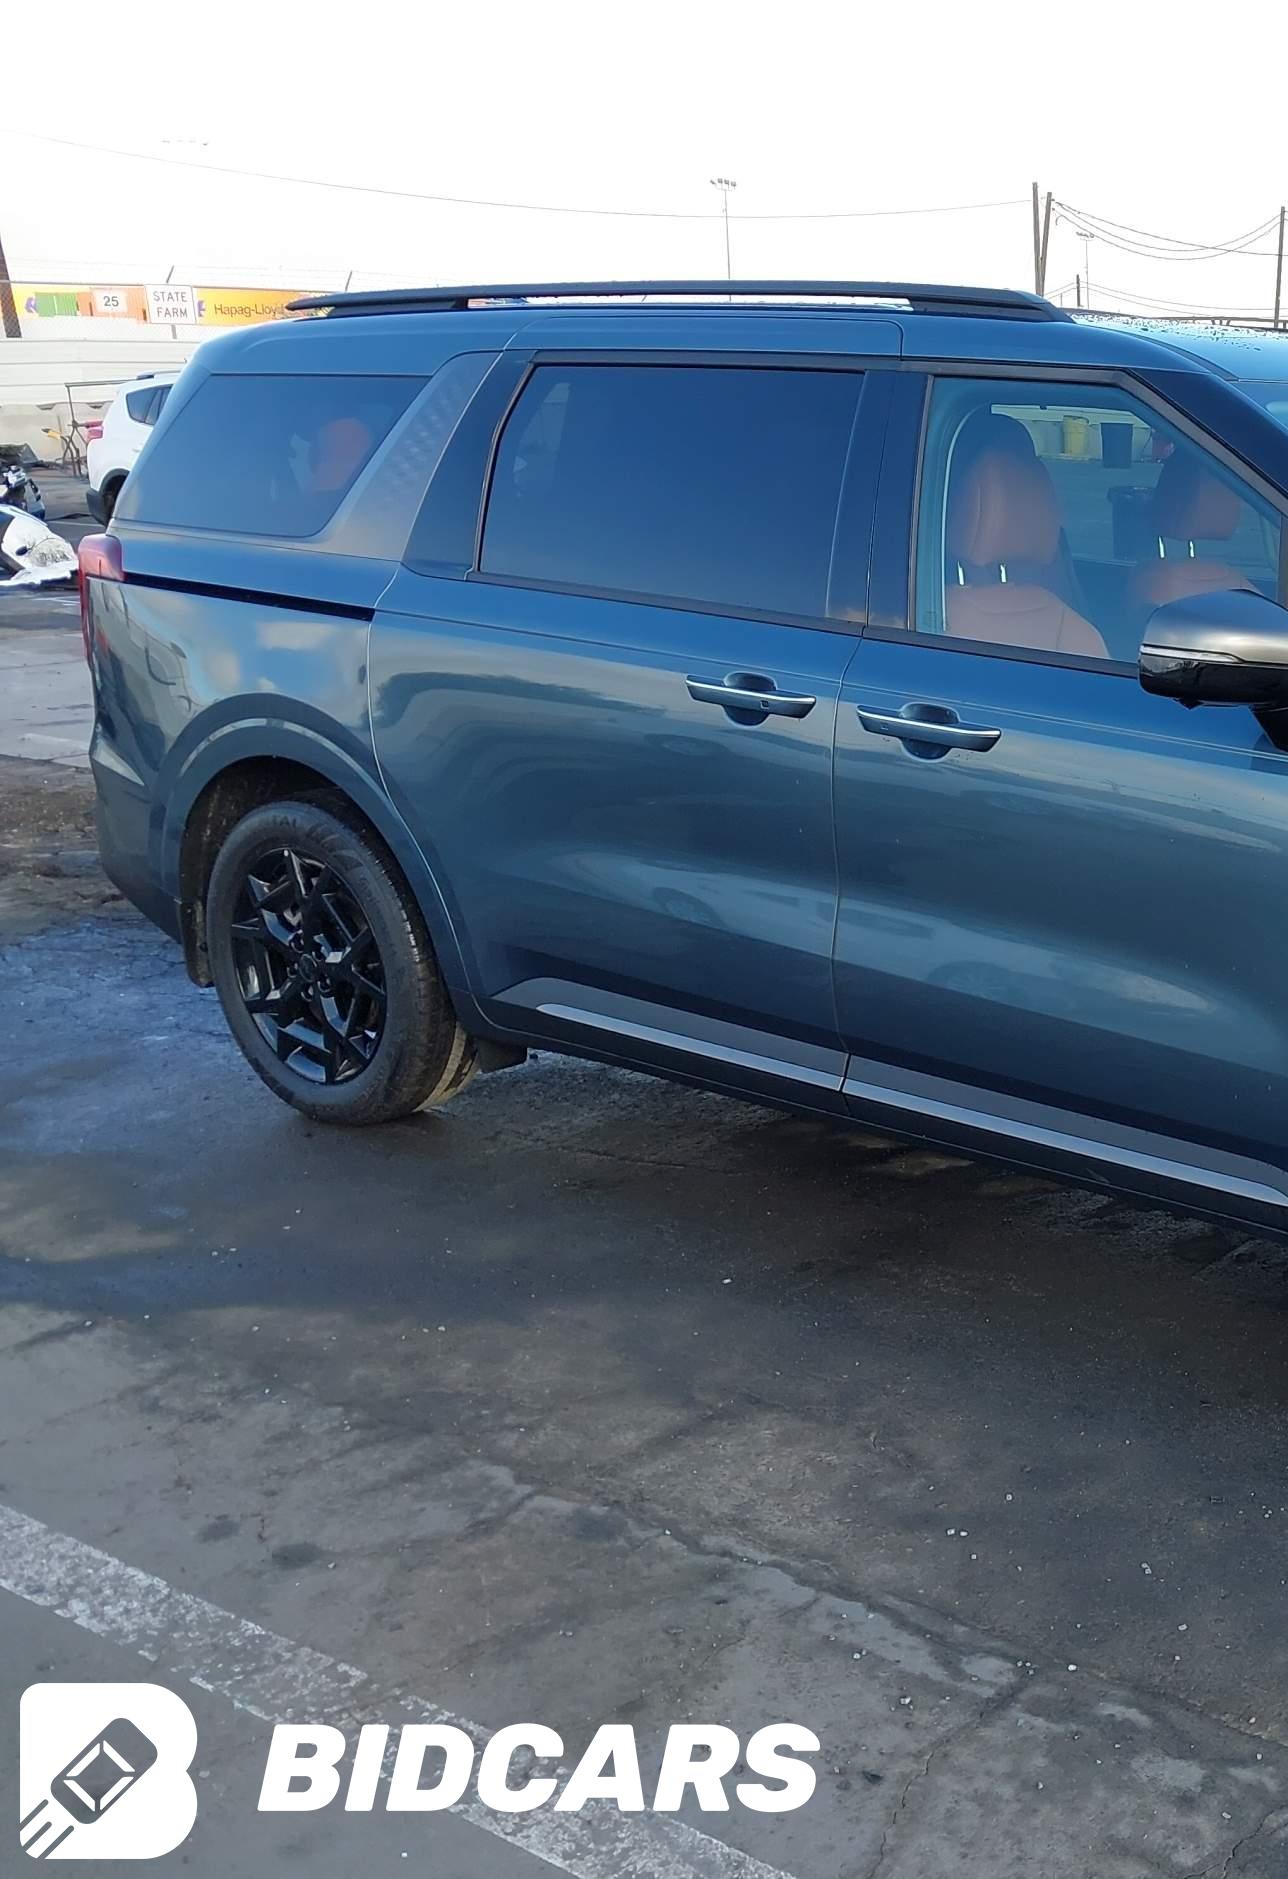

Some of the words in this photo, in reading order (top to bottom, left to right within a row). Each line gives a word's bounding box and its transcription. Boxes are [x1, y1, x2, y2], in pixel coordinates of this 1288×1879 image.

[103, 295, 120, 307] 25
[152, 291, 188, 302] STATE
[156, 307, 188, 318] FARM
